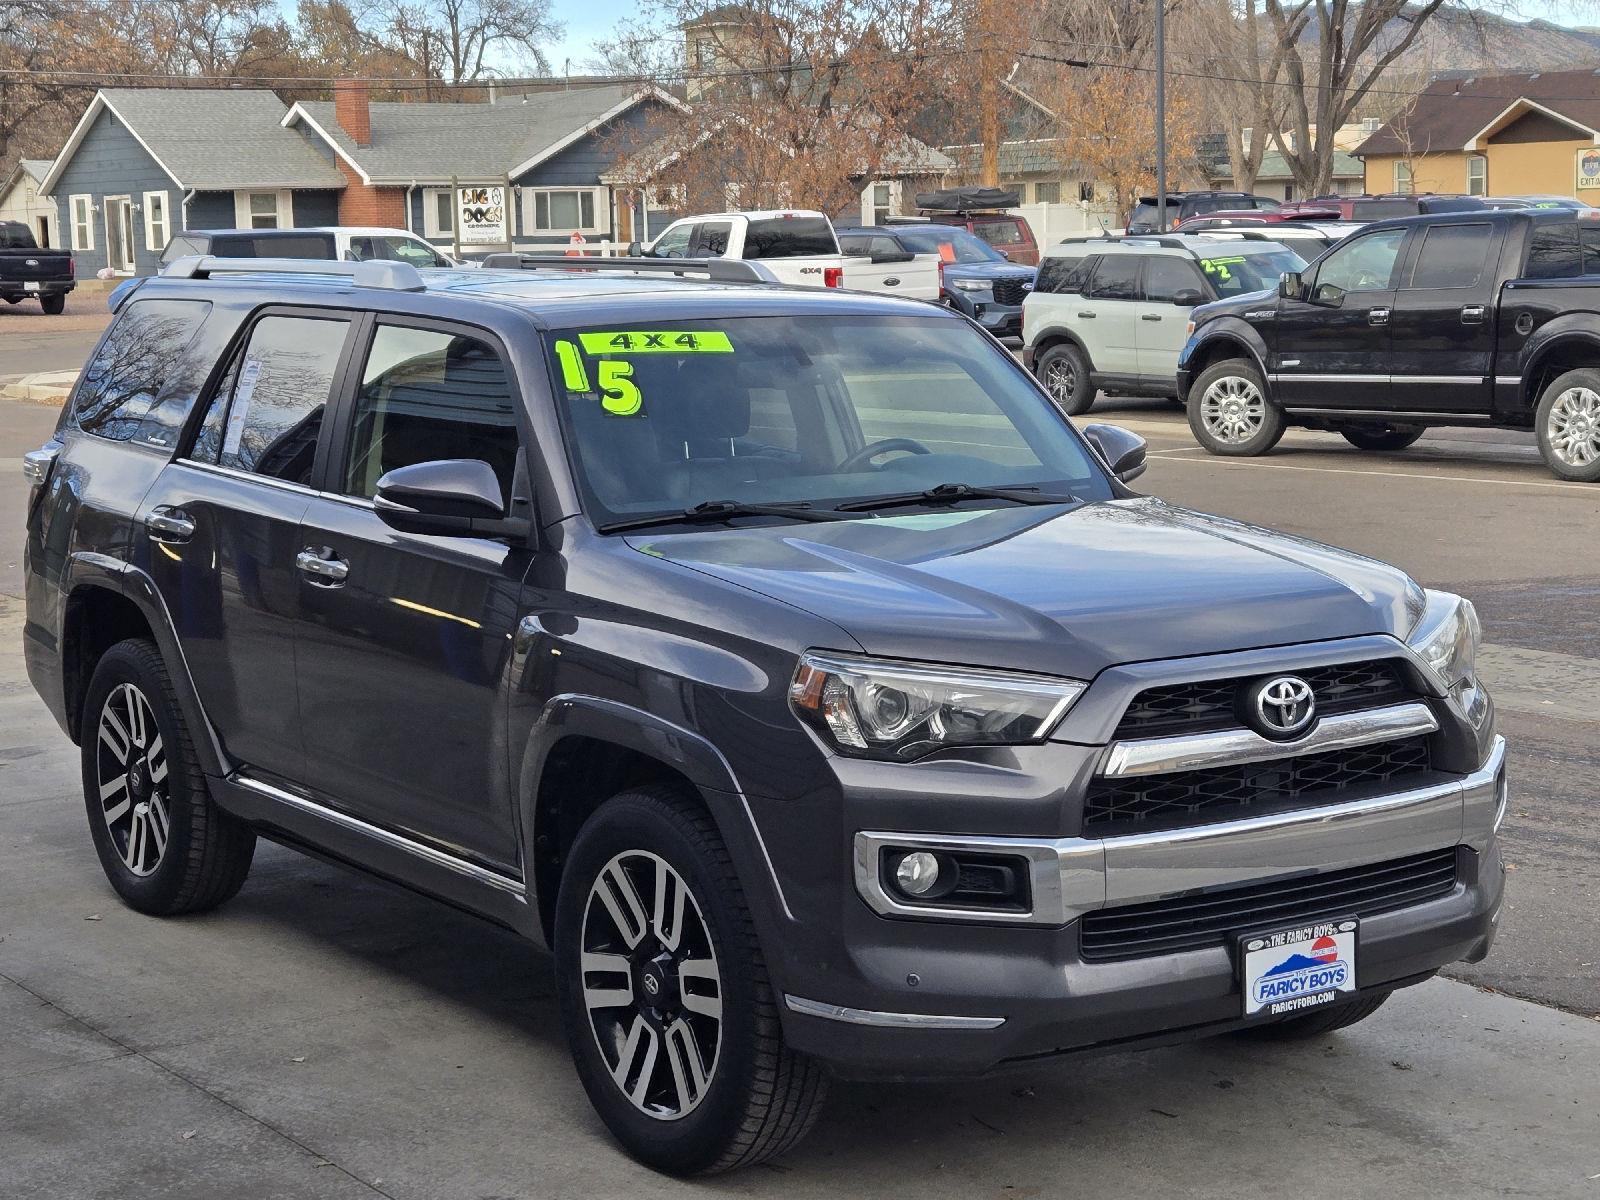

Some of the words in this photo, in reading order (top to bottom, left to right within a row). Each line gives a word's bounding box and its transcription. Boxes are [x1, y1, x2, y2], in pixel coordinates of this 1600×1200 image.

[1580, 177, 1595, 186] EXIT
[463, 206, 503, 223] DOGS
[1271, 932, 1286, 947] THE
[1286, 927, 1314, 944] FARICY
[1313, 923, 1334, 938] BOYS
[1260, 976, 1308, 999] FARICY
[1309, 968, 1345, 988] BOYS
[1271, 991, 1335, 1015] FARICYFORD.COM
